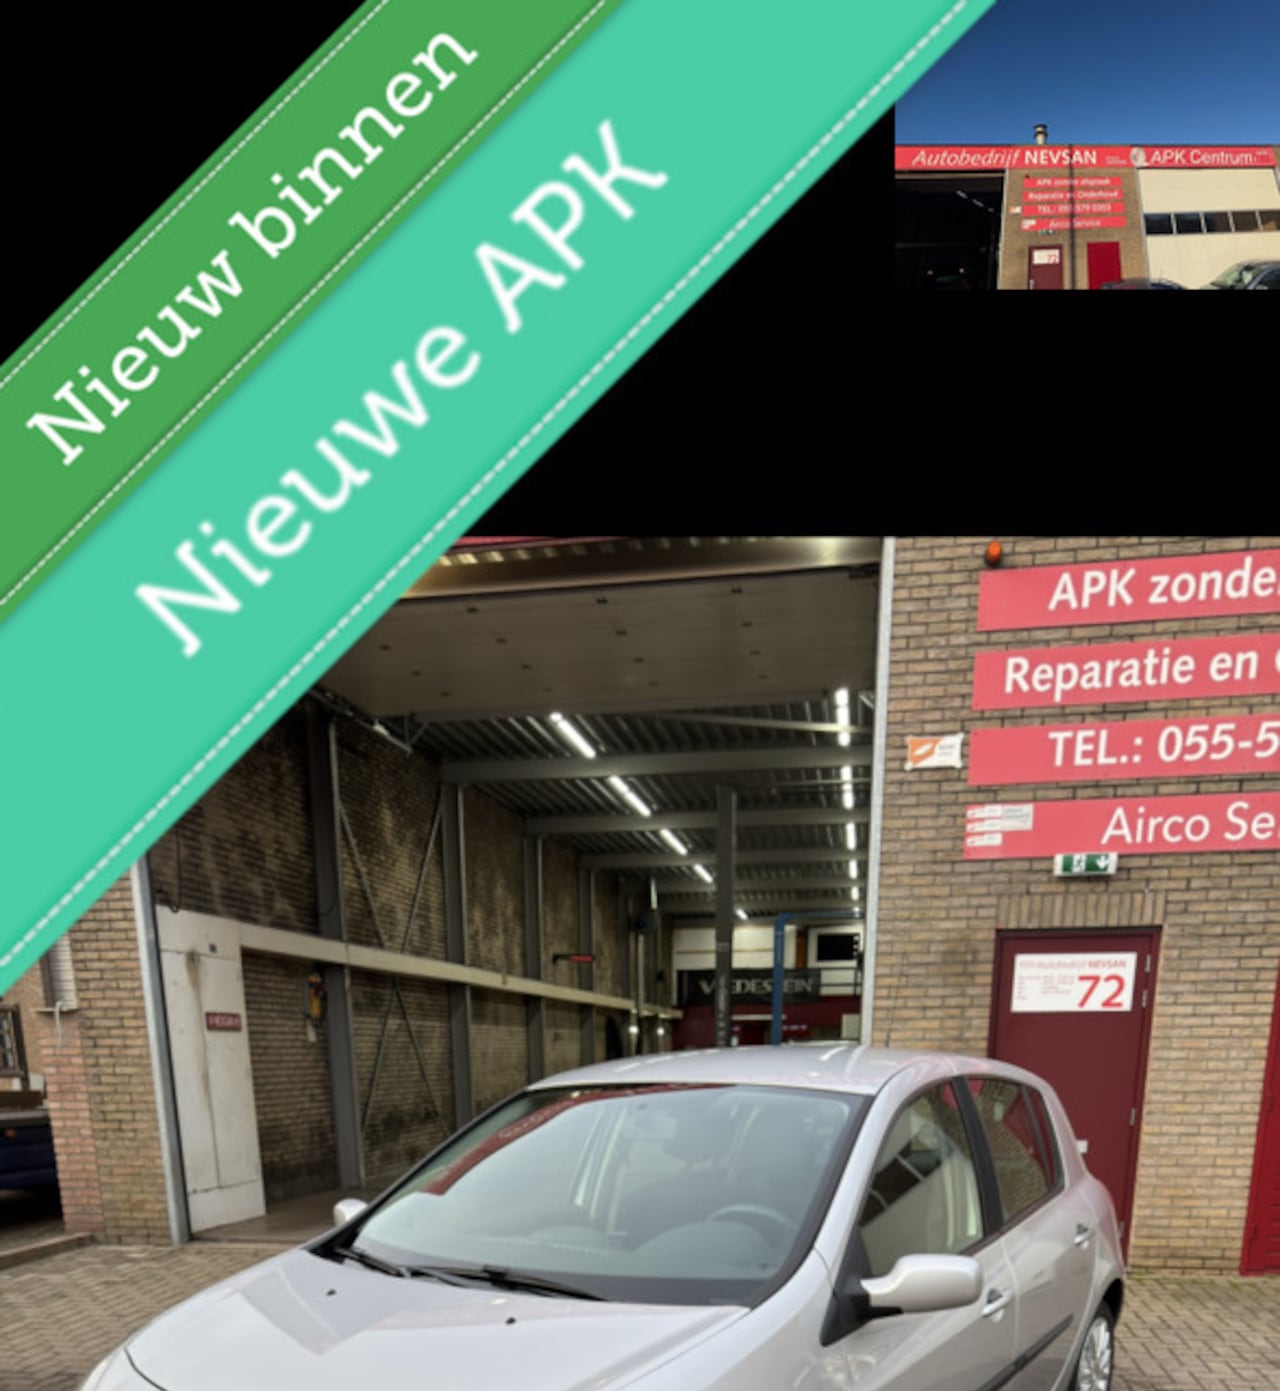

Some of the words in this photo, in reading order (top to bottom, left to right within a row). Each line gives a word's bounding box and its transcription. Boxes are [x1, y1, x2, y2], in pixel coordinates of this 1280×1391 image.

[912, 150, 1020, 168] Autobedrijf
[1024, 150, 1097, 165] NEVSAN
[1151, 150, 1186, 164] APK
[1190, 150, 1252, 165] Centrum
[1048, 568, 1135, 611] APK
[1148, 555, 1280, 604] zonde
[1005, 647, 1196, 703] Reparatie
[1209, 650, 1259, 682] en
[1048, 729, 1142, 767] TEL.:
[1158, 721, 1280, 762] 055-5
[1101, 806, 1211, 845] Airco
[1223, 800, 1280, 840] Se
[1078, 974, 1126, 1008] 72
